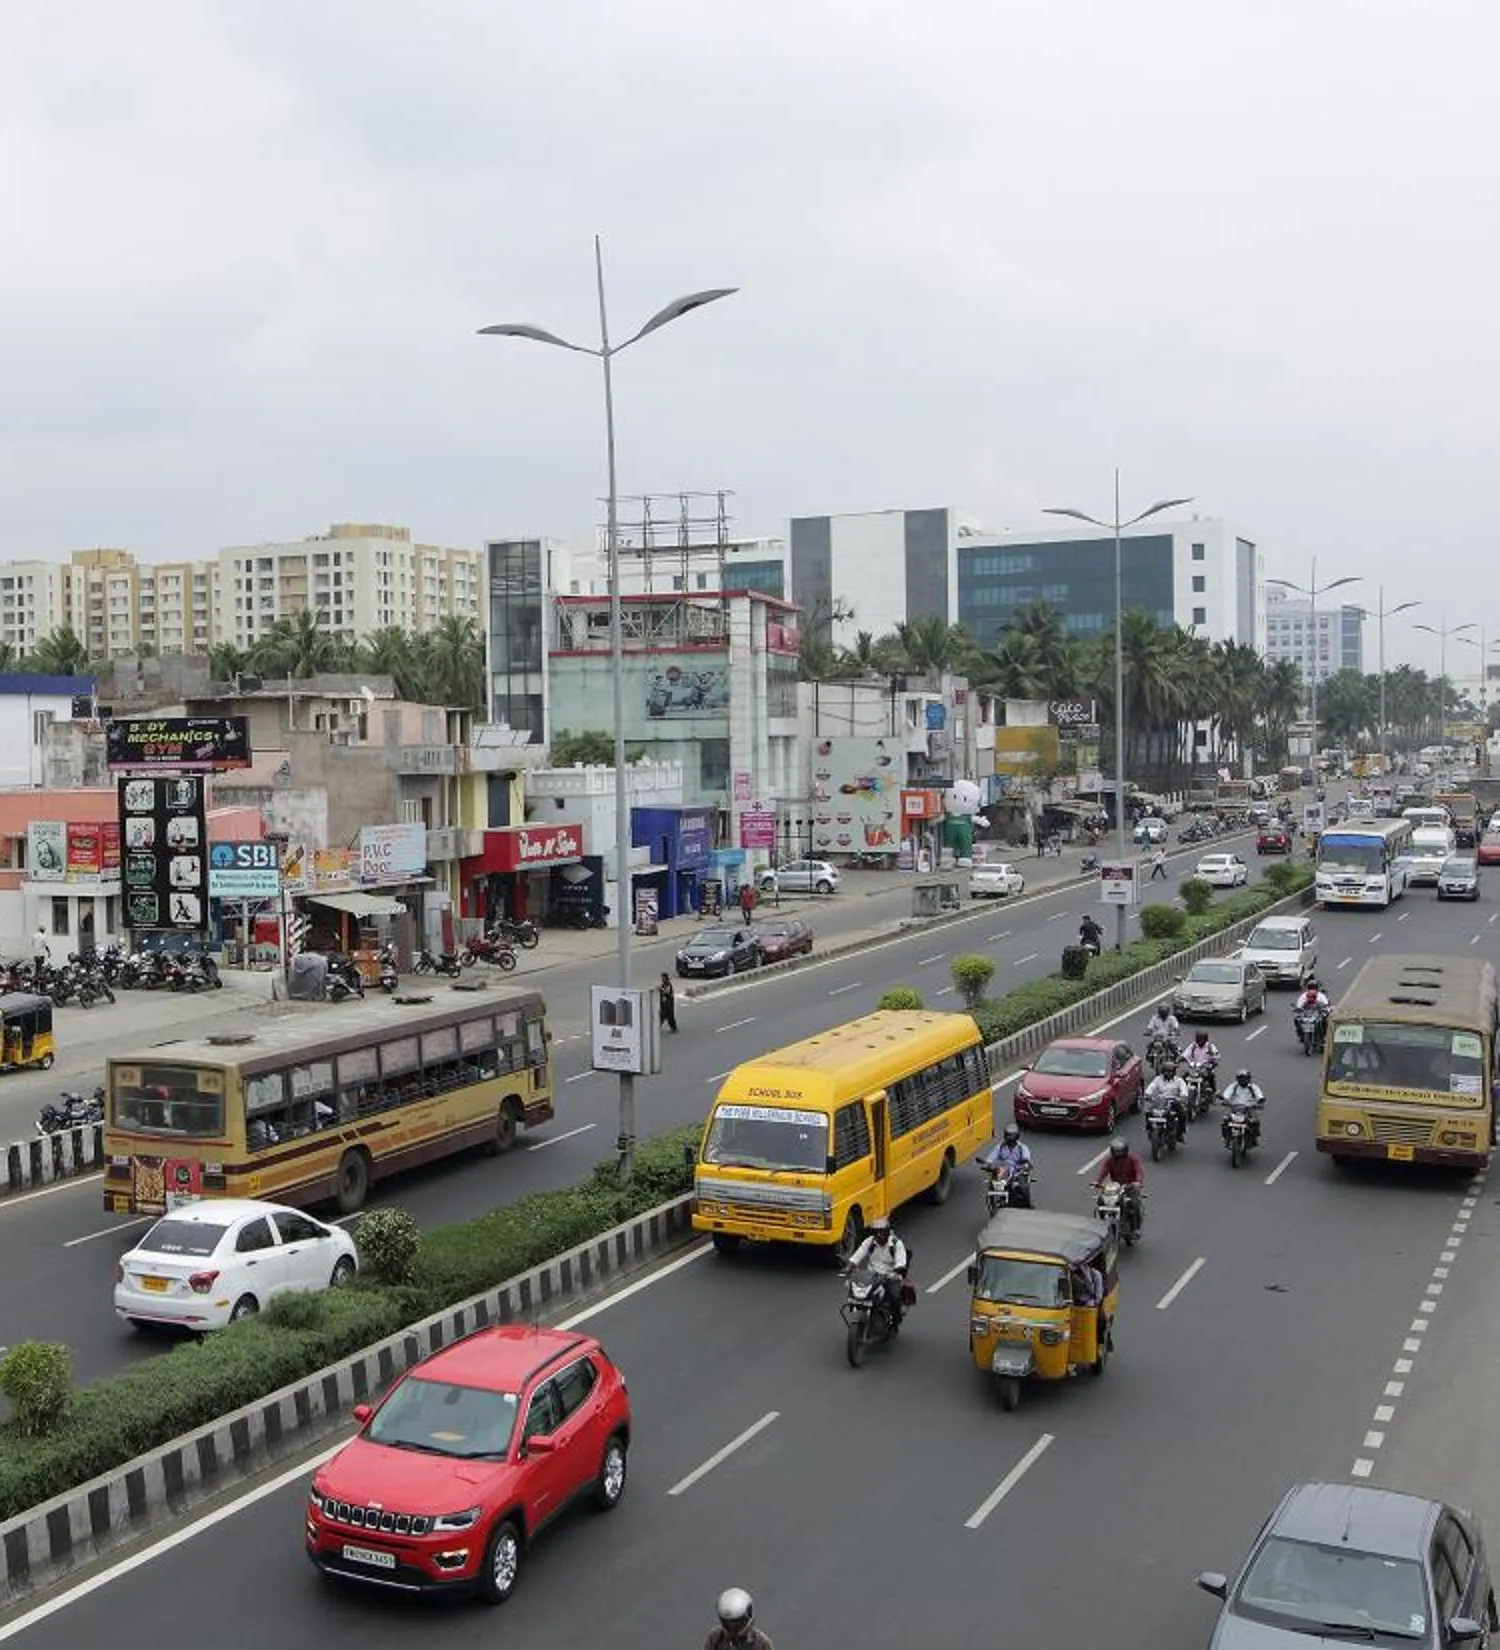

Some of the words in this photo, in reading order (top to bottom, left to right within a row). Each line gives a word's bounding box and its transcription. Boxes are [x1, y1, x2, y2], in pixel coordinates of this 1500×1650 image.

[127, 730, 213, 744] MECHANICS
[237, 845, 277, 867] SBI
[748, 1088, 781, 1099] SCHOOL
